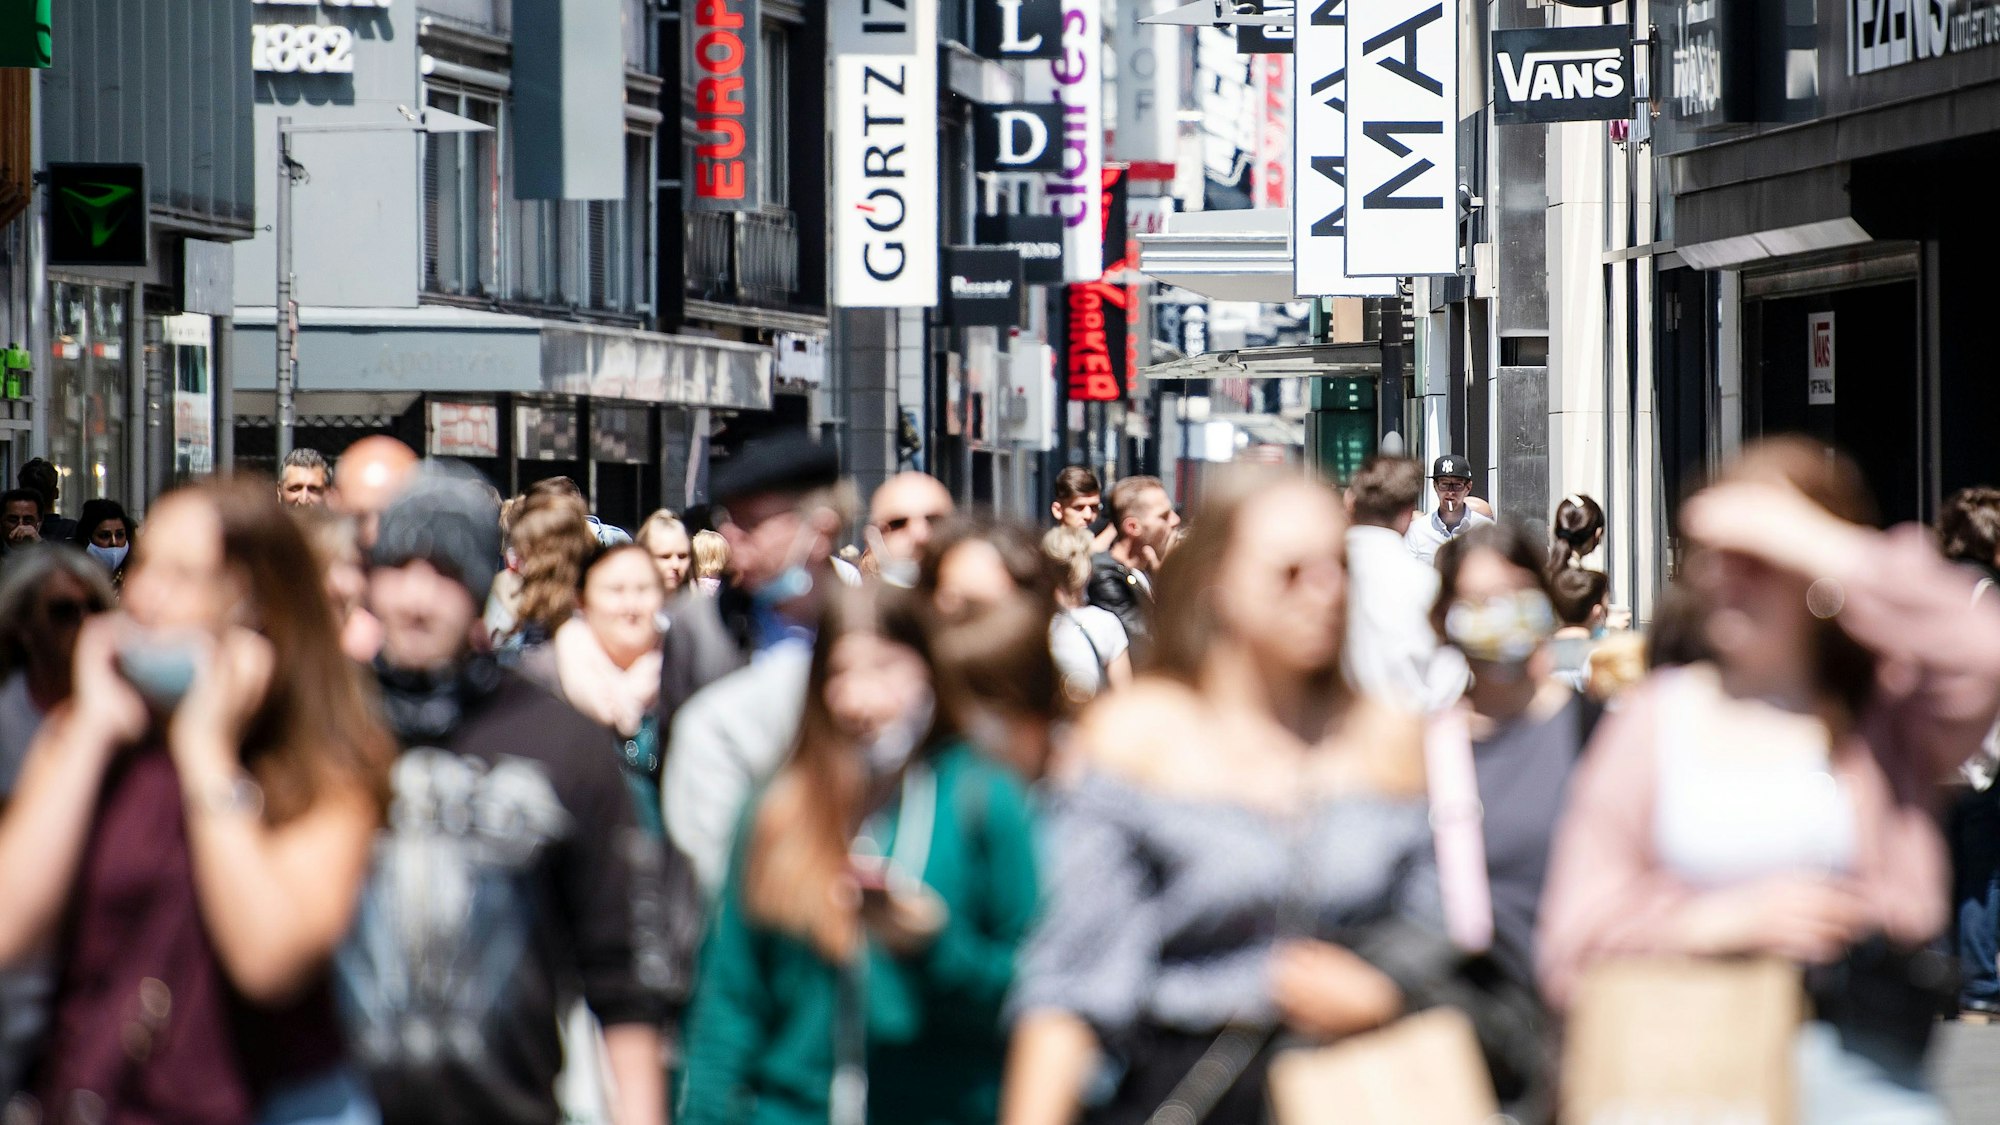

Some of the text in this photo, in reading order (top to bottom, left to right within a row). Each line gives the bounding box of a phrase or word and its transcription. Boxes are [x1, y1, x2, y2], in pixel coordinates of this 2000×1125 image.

[252, 23, 354, 73] 1882
[695, 0, 745, 199] EUROP
[1362, 2, 1444, 210] MA
[1496, 48, 1625, 102] VANS
